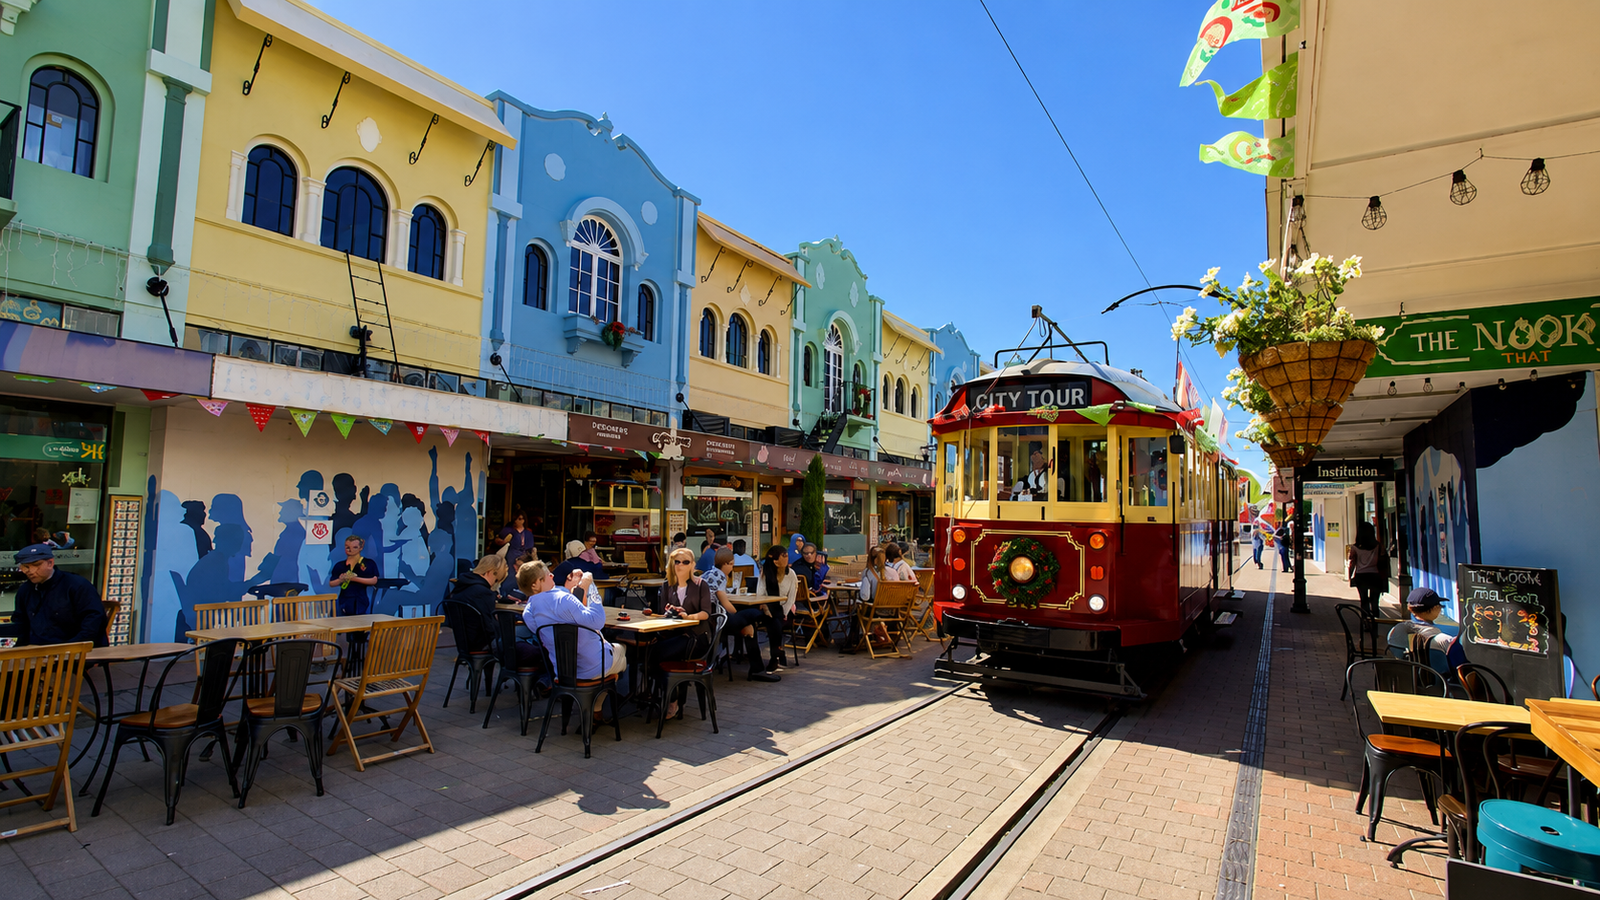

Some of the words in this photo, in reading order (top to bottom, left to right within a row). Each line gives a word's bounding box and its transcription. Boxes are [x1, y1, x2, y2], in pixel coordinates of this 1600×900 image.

[1410, 330, 1459, 352] THE
[1472, 312, 1596, 351] NOOK
[1501, 350, 1552, 363] THAT
[976, 391, 1021, 410] CITY
[1027, 388, 1085, 408] TOUR
[1317, 465, 1378, 478] Institution
